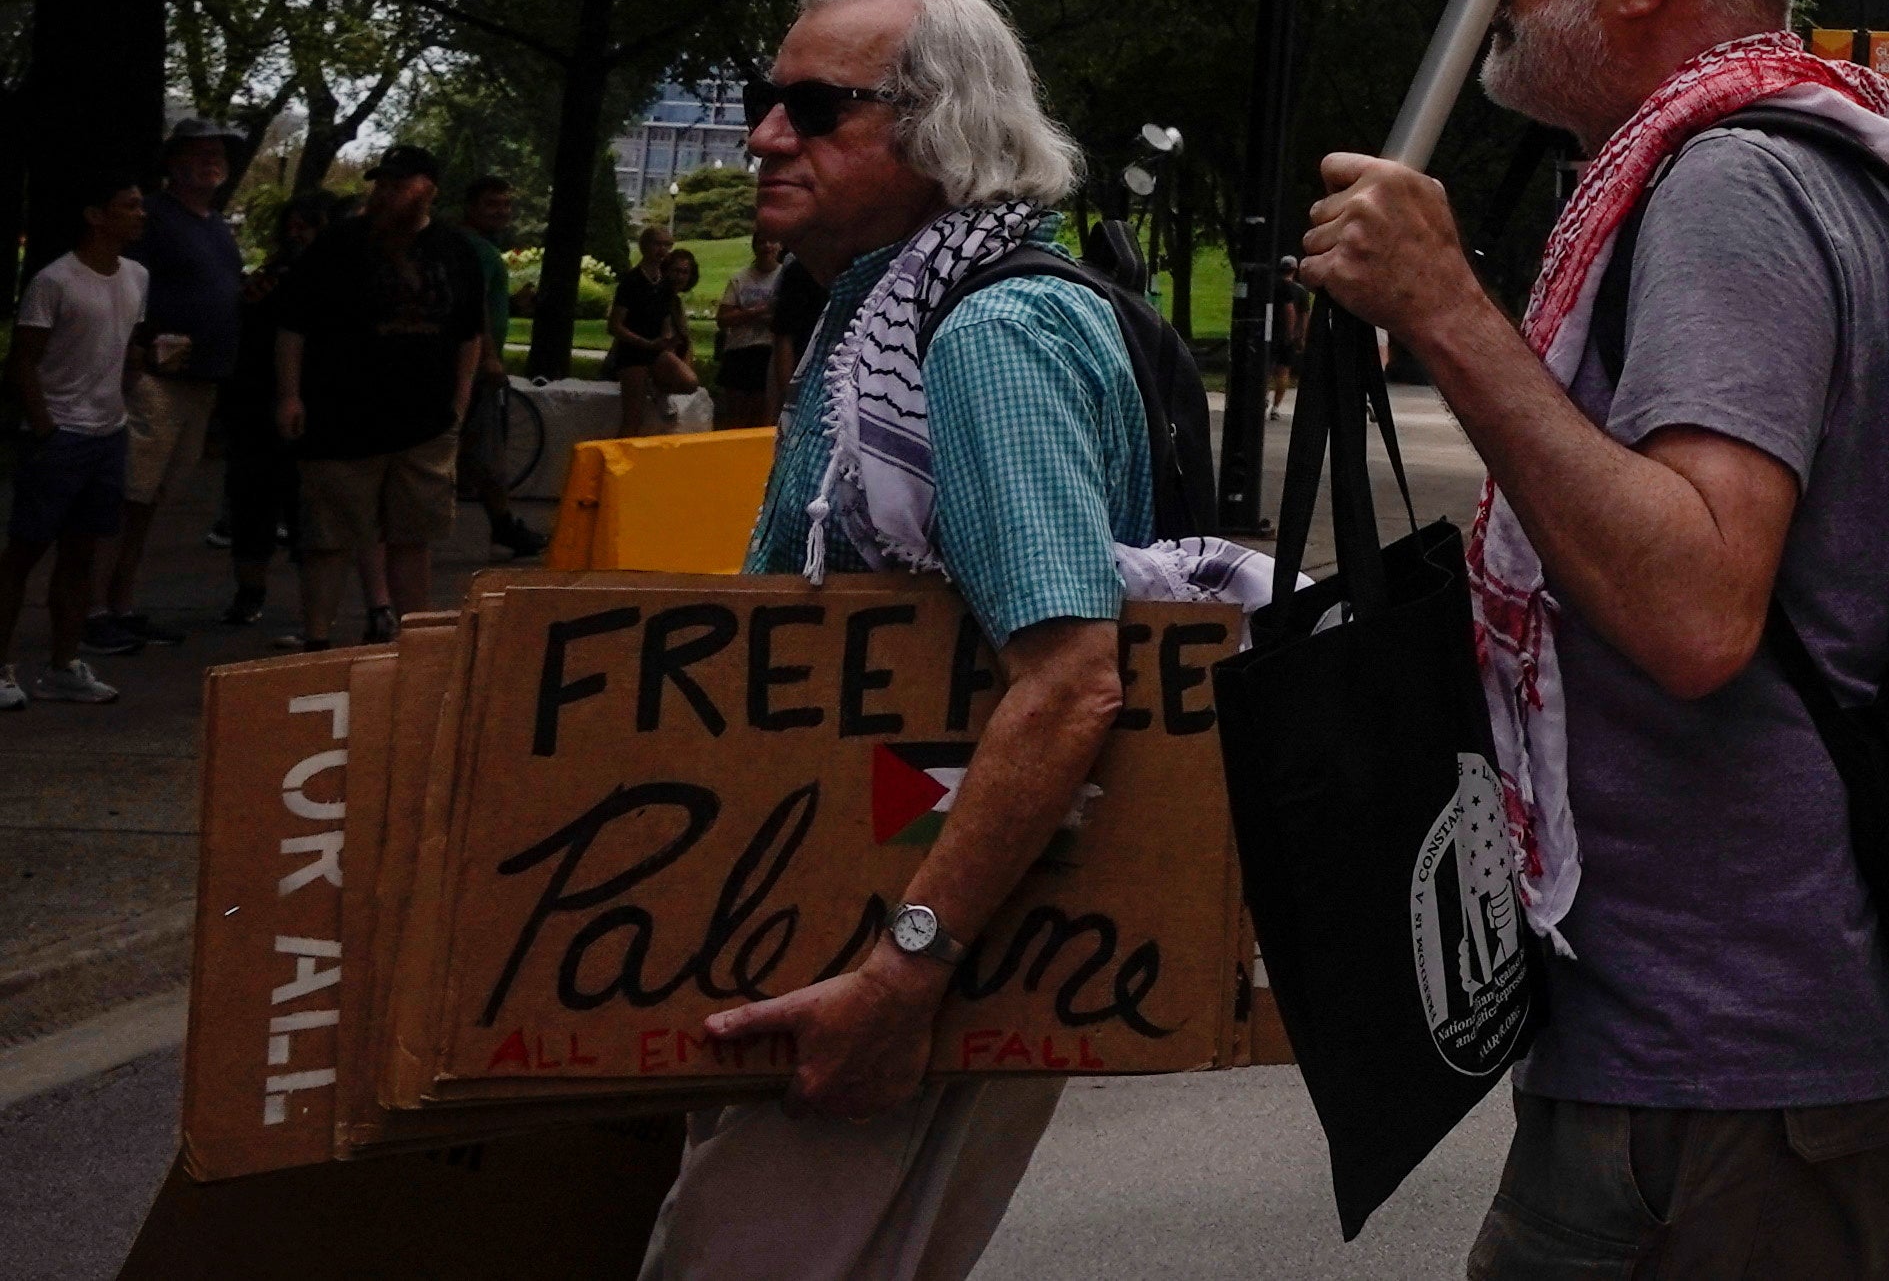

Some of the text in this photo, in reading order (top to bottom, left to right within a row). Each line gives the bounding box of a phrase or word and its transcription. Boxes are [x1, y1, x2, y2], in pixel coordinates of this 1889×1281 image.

[529, 604, 1229, 757] FREE FEE
[274, 691, 350, 900] FOR
[1417, 801, 1465, 883] CONSTAN
[1414, 912, 1423, 930] IS
[1415, 891, 1425, 904] A
[262, 935, 343, 1127] ALL
[487, 1029, 598, 1071] ALL
[962, 1028, 1105, 1071] FALL
